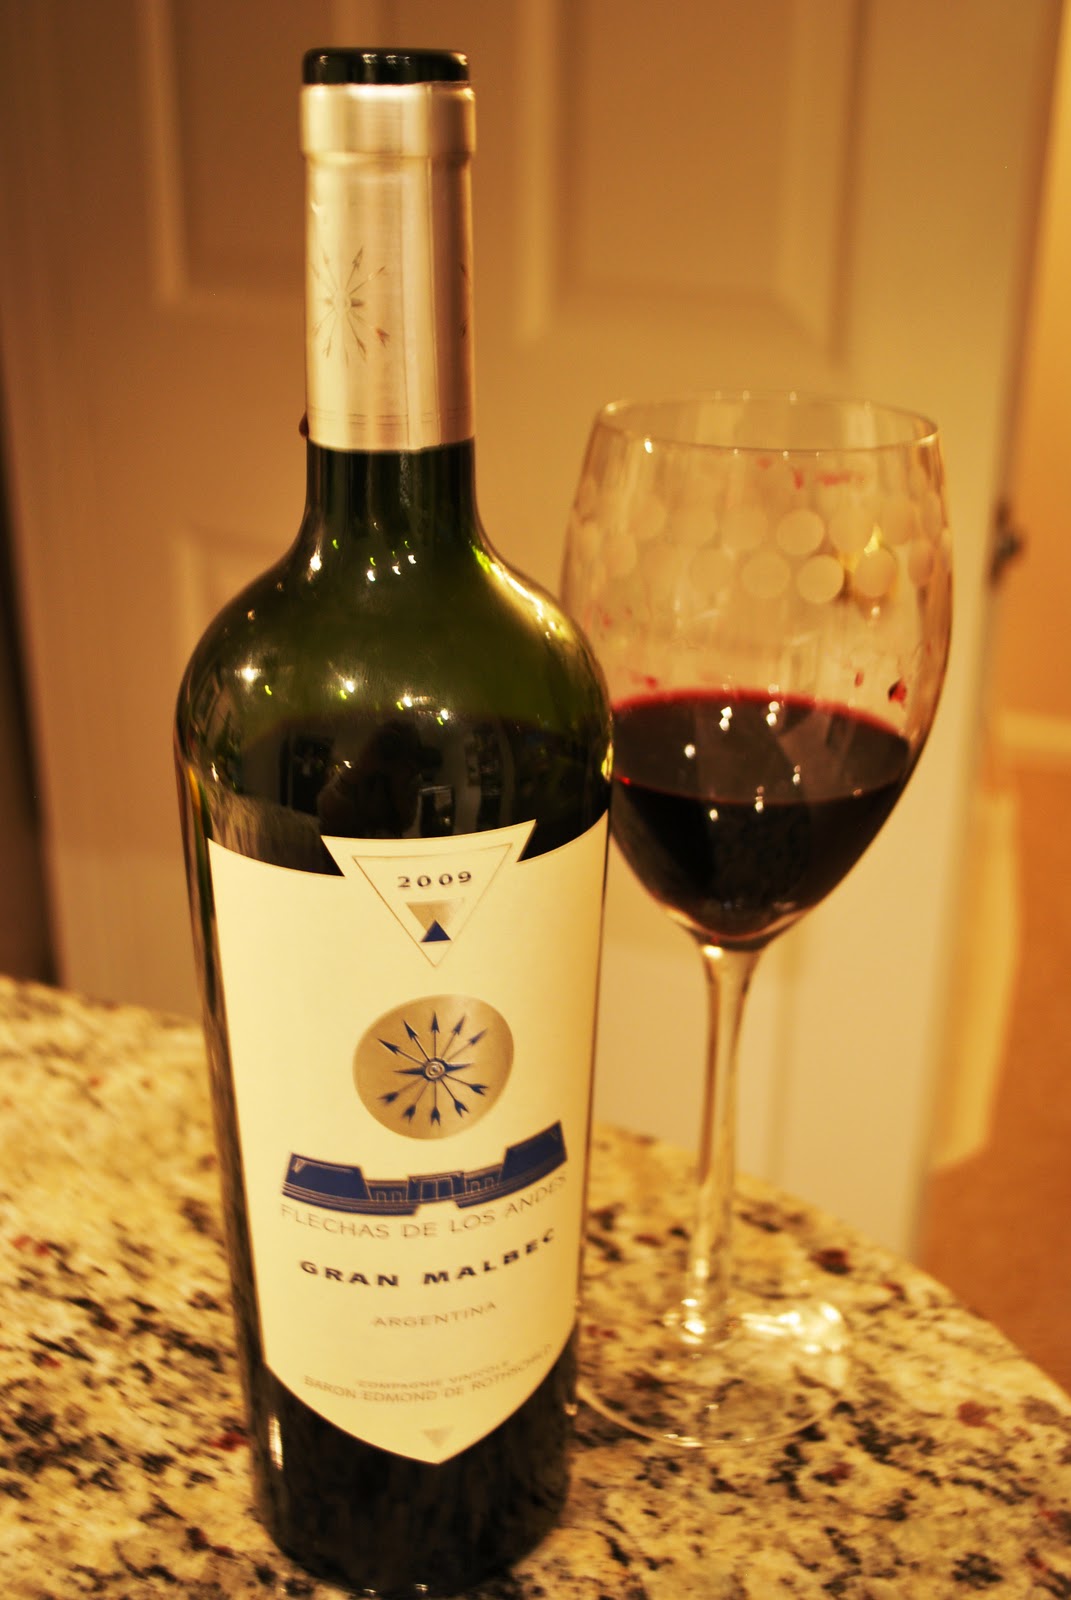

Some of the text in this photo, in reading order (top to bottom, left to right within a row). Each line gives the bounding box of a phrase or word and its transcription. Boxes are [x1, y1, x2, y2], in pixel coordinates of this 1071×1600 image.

[397, 871, 472, 888] 2009
[281, 1174, 568, 1239] FLECHAS DE LOS ANDES
[300, 1227, 555, 1287] GRAN MALBEC
[373, 1302, 497, 1328] ARGENTINA
[304, 1375, 357, 1401] BARON
[363, 1389, 438, 1403] EDMOND
[444, 1386, 465, 1398] DE
